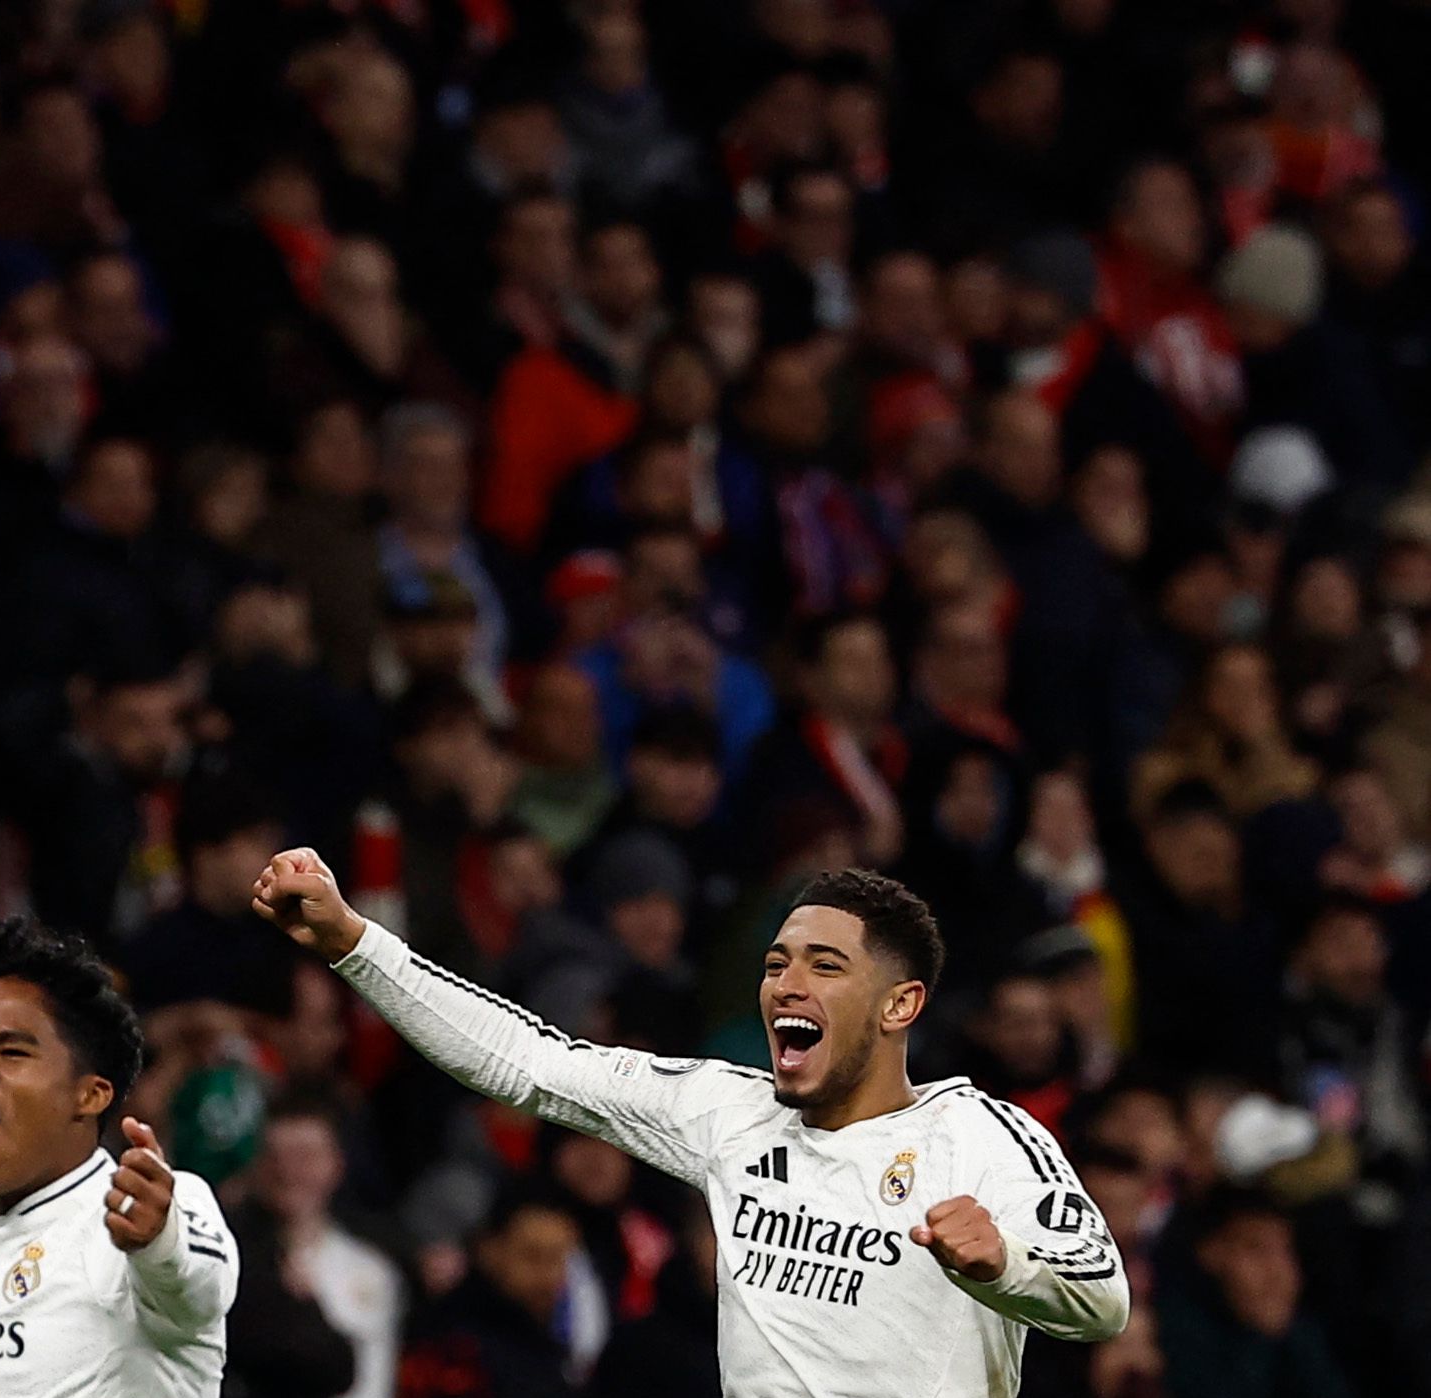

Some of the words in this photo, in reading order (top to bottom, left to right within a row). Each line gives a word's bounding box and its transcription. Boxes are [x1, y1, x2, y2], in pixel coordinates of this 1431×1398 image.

[732, 1193, 903, 1266] Emirates
[733, 1250, 777, 1288] FLY
[776, 1258, 864, 1306] BETTER
